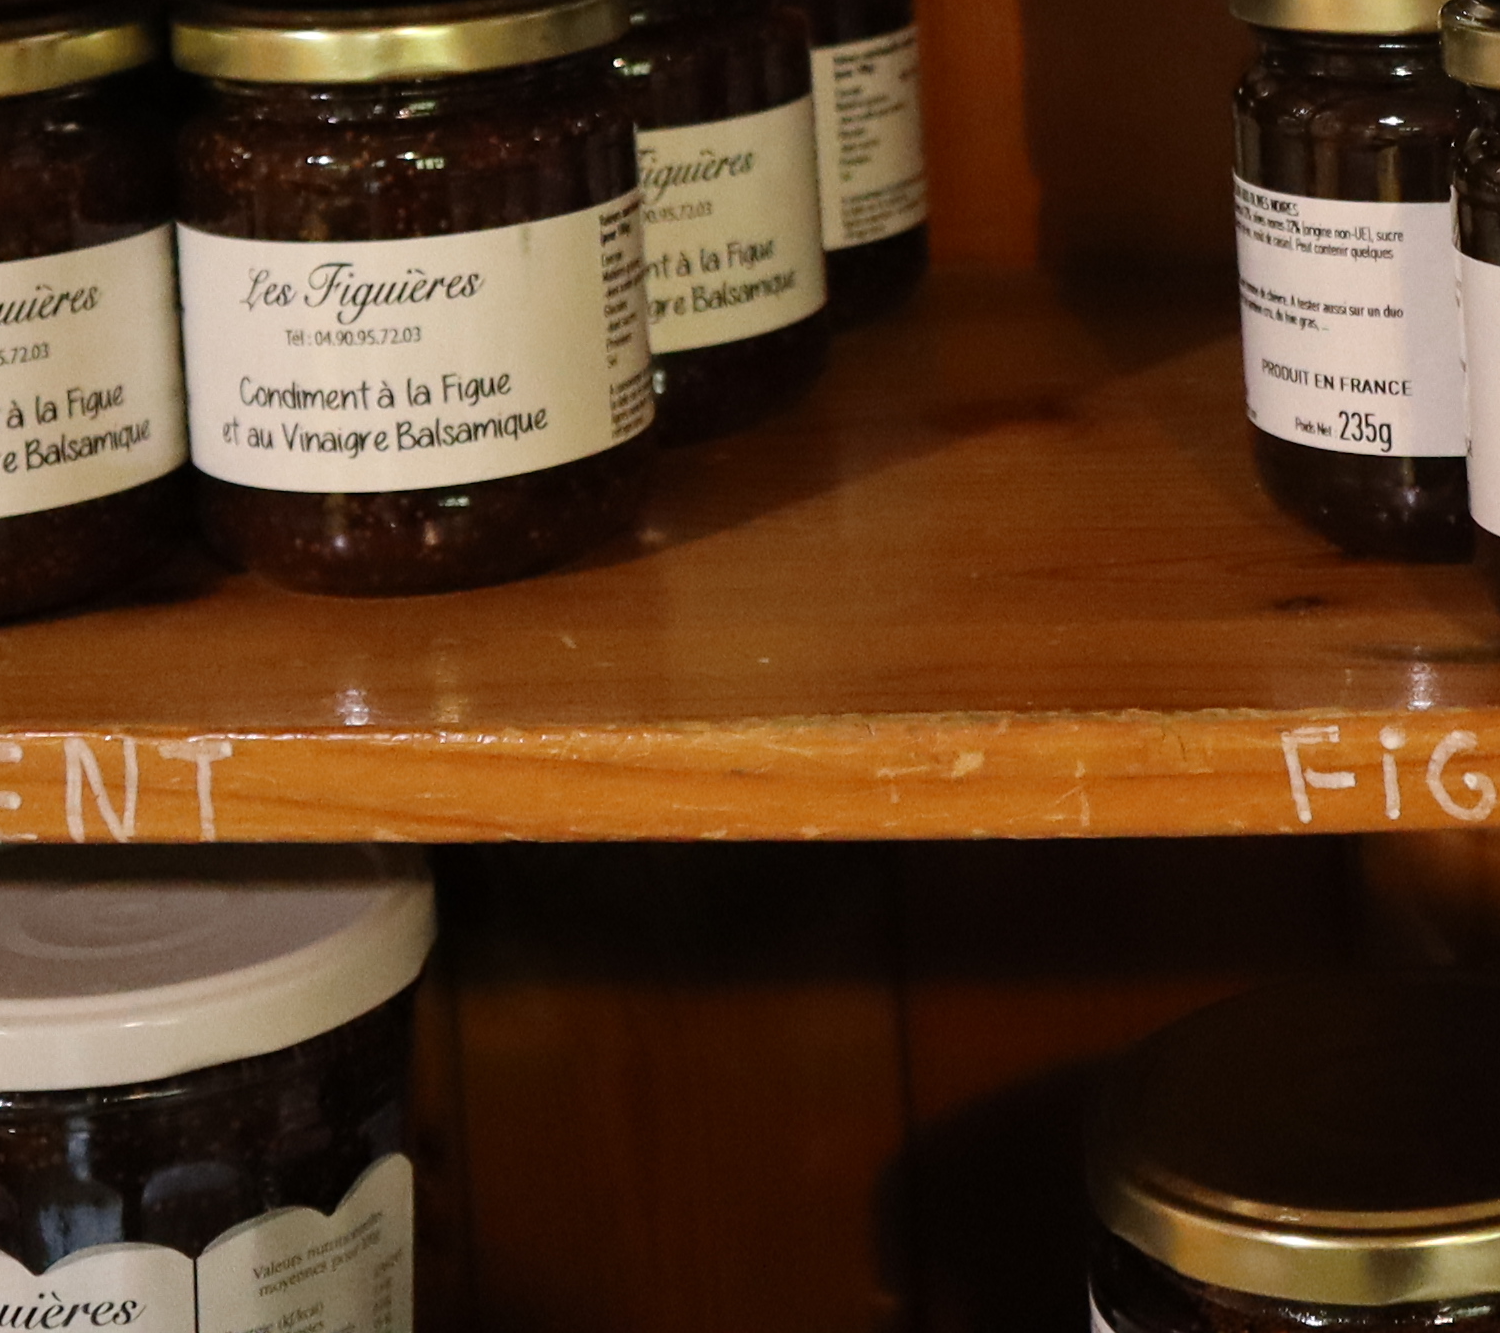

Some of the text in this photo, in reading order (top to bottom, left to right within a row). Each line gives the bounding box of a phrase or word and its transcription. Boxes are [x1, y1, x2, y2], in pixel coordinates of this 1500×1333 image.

[1384, 305, 1403, 318] duo
[1262, 359, 1412, 395] PRODUIT EN FRANCE
[1339, 411, 1392, 452] 235g
